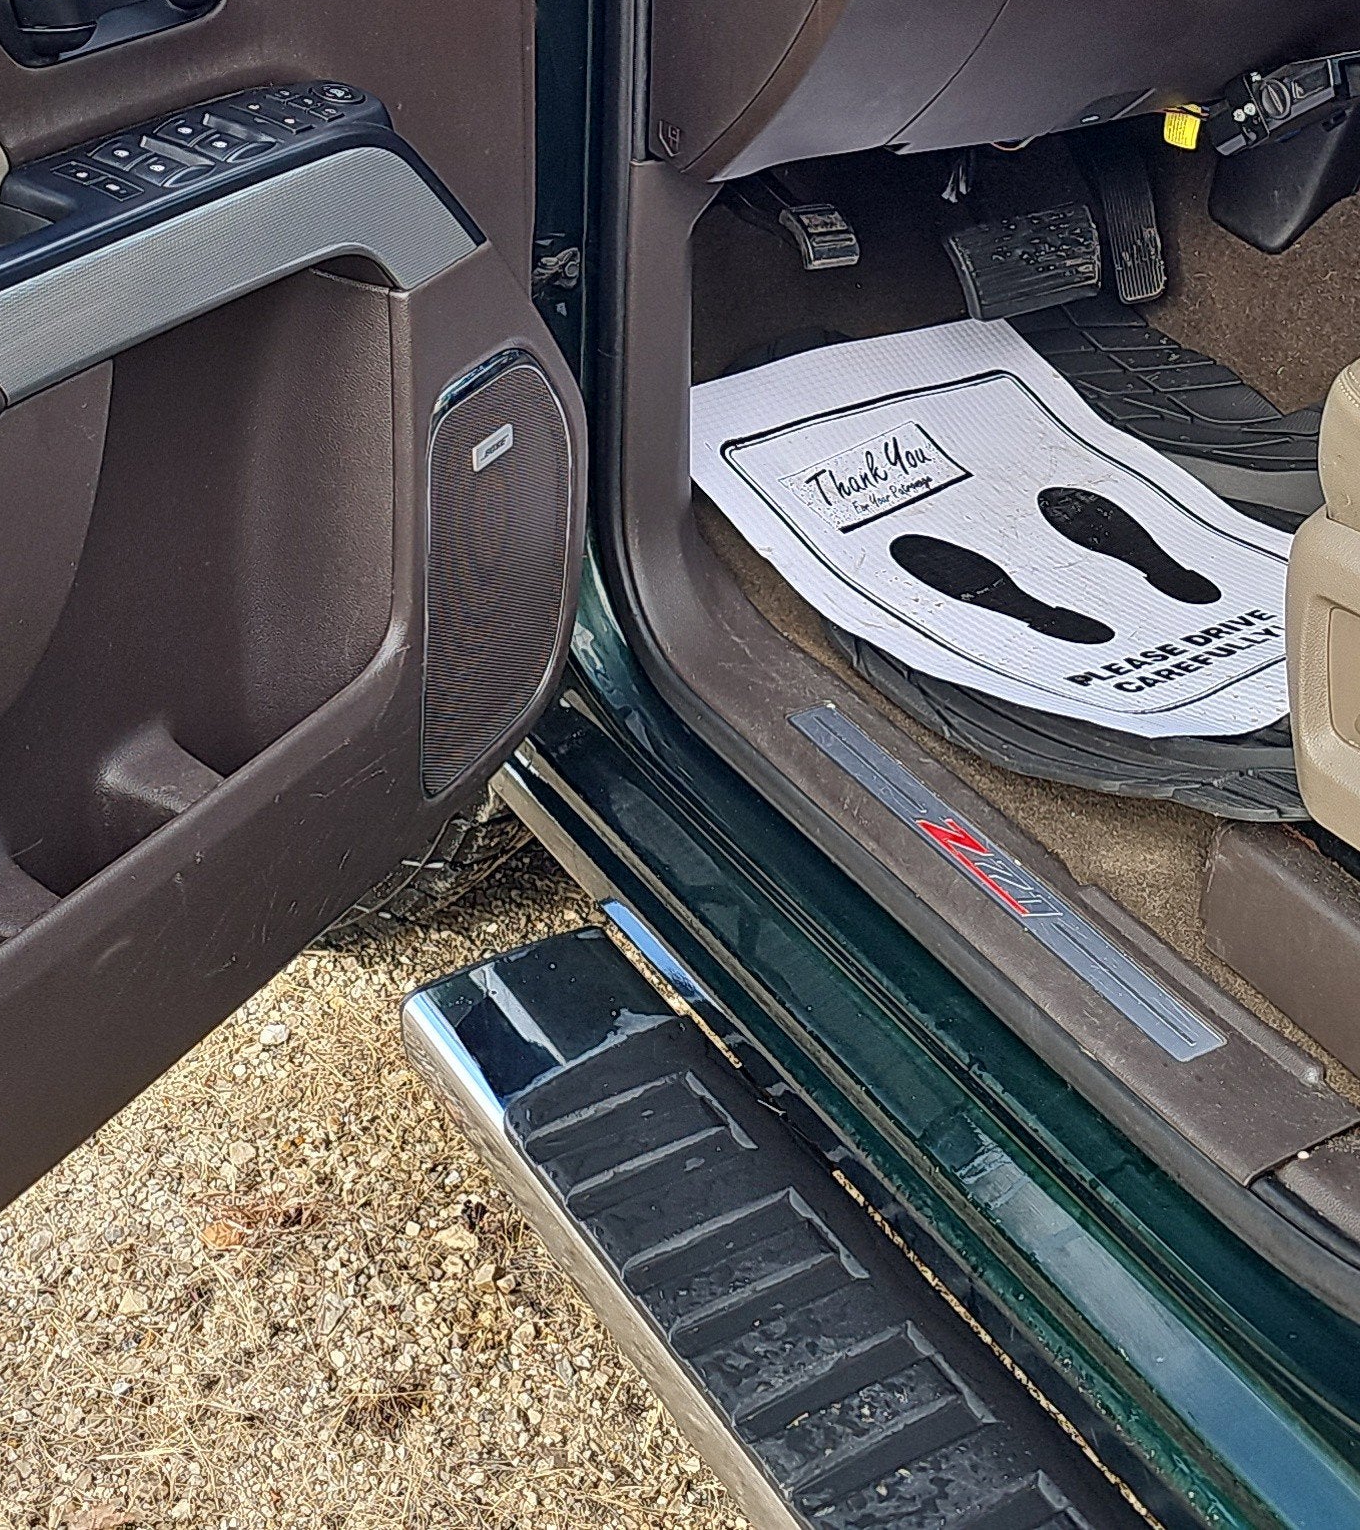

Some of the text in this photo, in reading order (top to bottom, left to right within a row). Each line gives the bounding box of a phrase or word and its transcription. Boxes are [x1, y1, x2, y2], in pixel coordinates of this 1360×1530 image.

[805, 436, 932, 506] Thank You
[852, 500, 870, 515] For
[868, 495, 890, 508] Your
[1063, 608, 1278, 687] PLEASE DRIVE
[916, 818, 1064, 918] Z71
